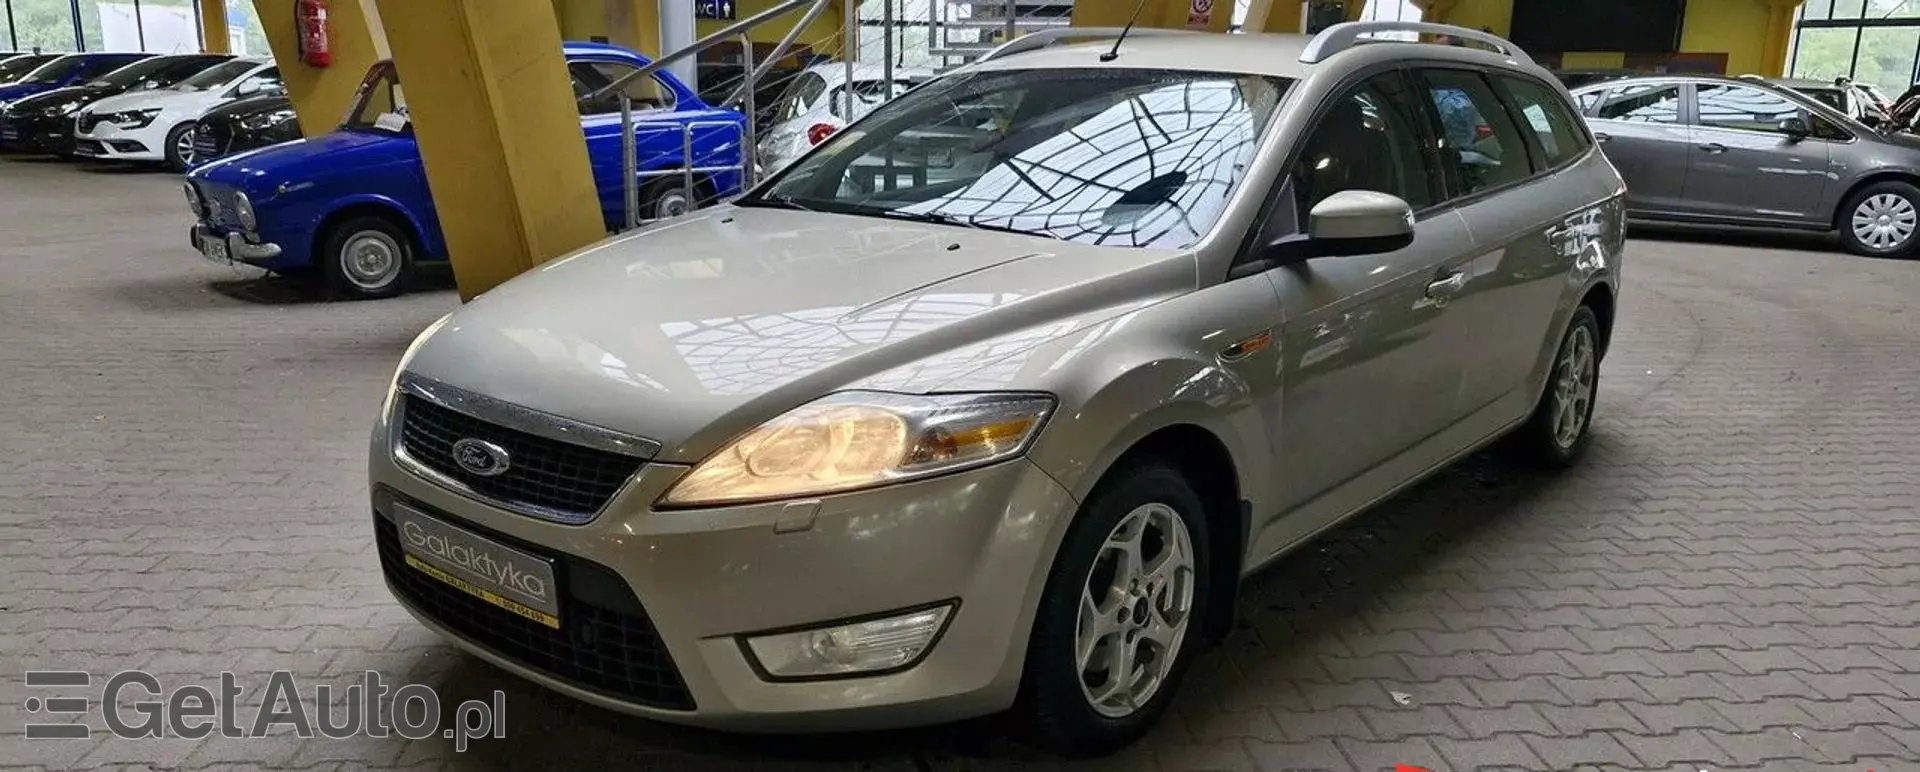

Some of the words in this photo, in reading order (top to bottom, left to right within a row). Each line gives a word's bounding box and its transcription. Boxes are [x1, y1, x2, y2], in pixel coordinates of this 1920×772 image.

[696, 3, 714, 15] WC
[463, 446, 487, 467] Ford
[403, 521, 546, 597] Galaktyka
